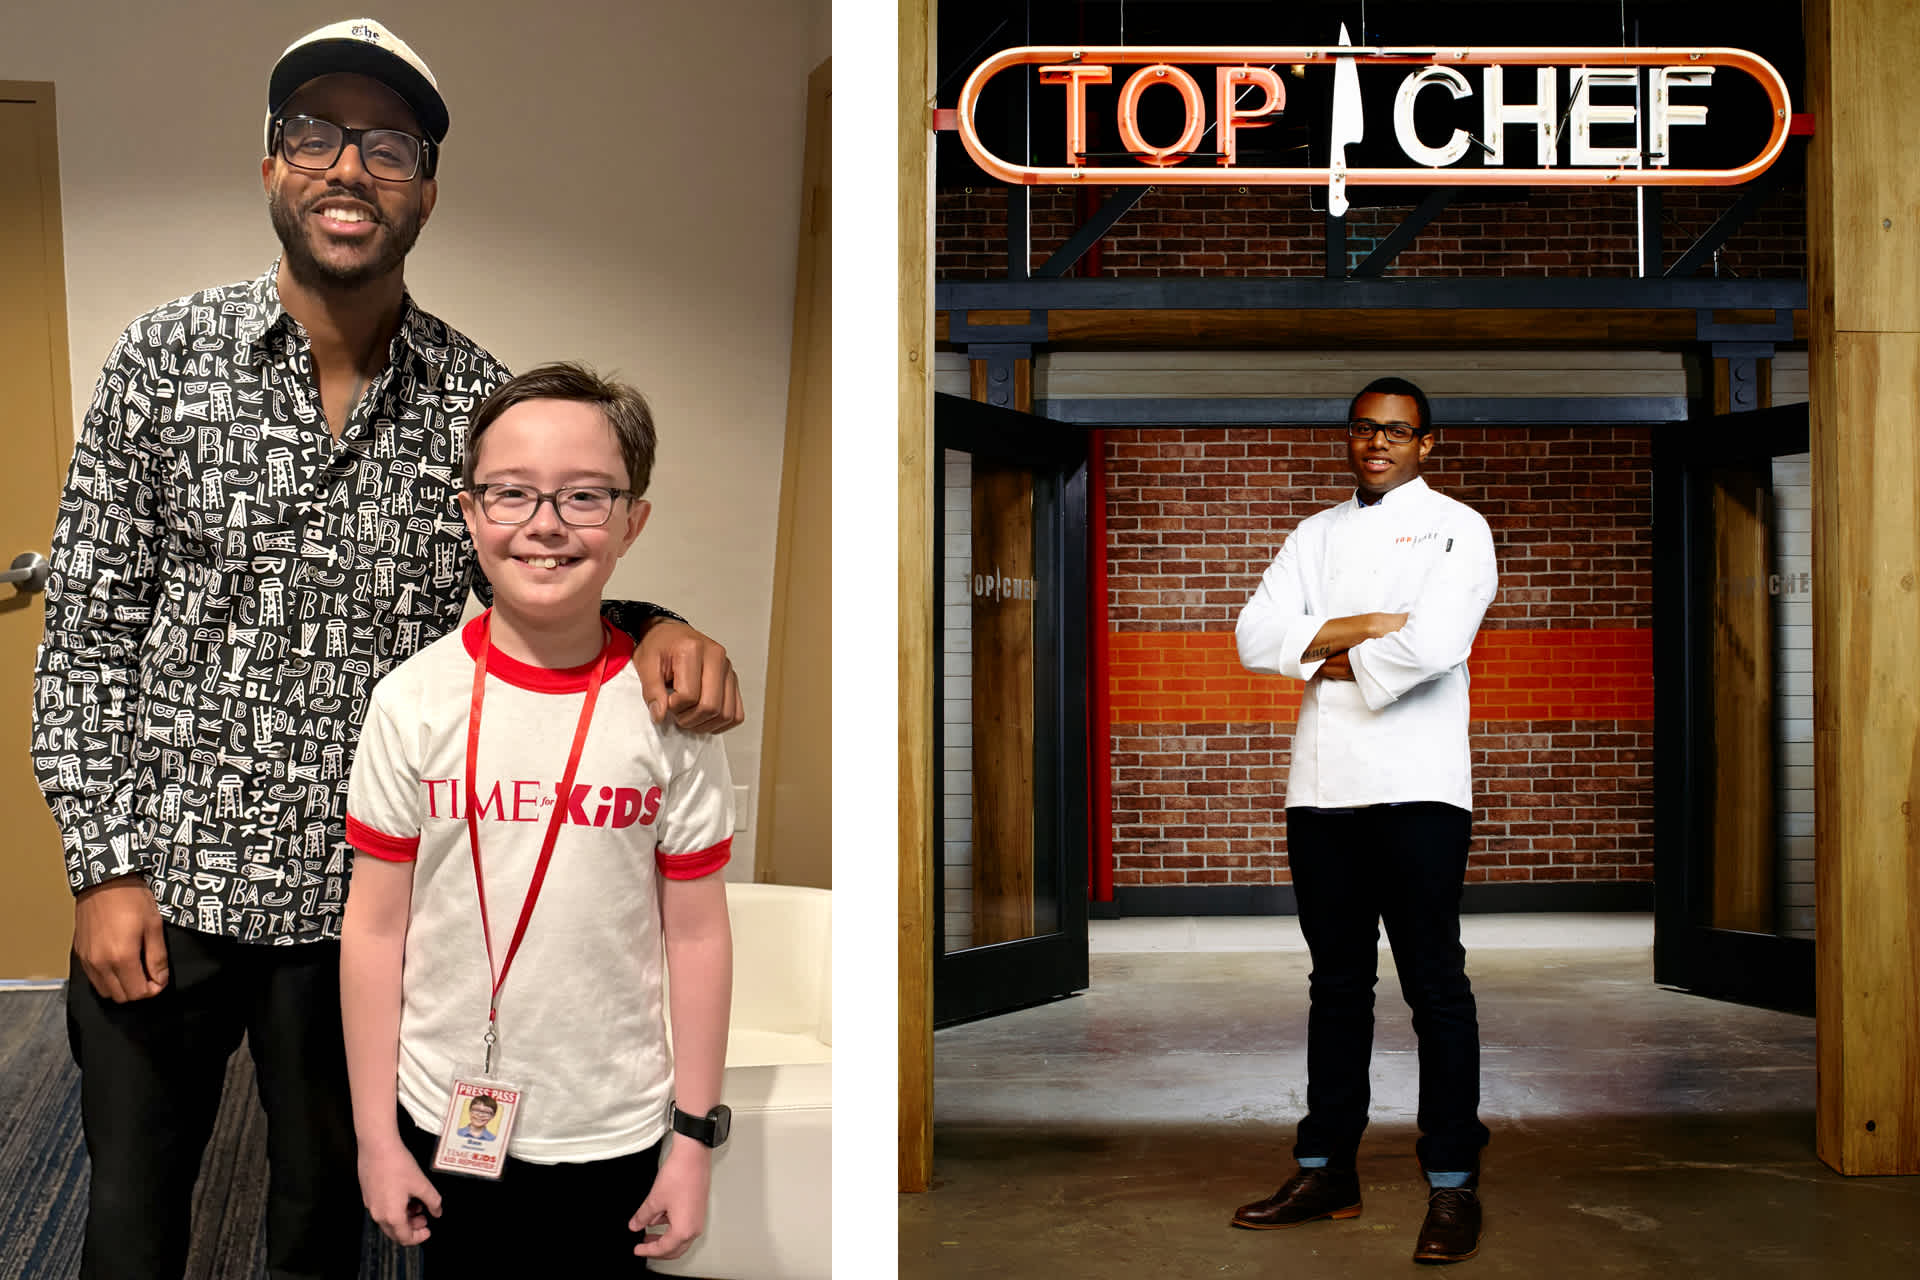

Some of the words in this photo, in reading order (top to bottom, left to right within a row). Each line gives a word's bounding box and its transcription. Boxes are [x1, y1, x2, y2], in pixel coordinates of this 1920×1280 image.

[352, 25, 380, 40] The
[1039, 64, 1286, 167] TOP
[1394, 65, 1716, 167] CHEF
[274, 709, 346, 743] BLACK
[420, 778, 541, 823] TIME
[460, 1084, 491, 1096] PRESS
[492, 1091, 515, 1103] PASS
